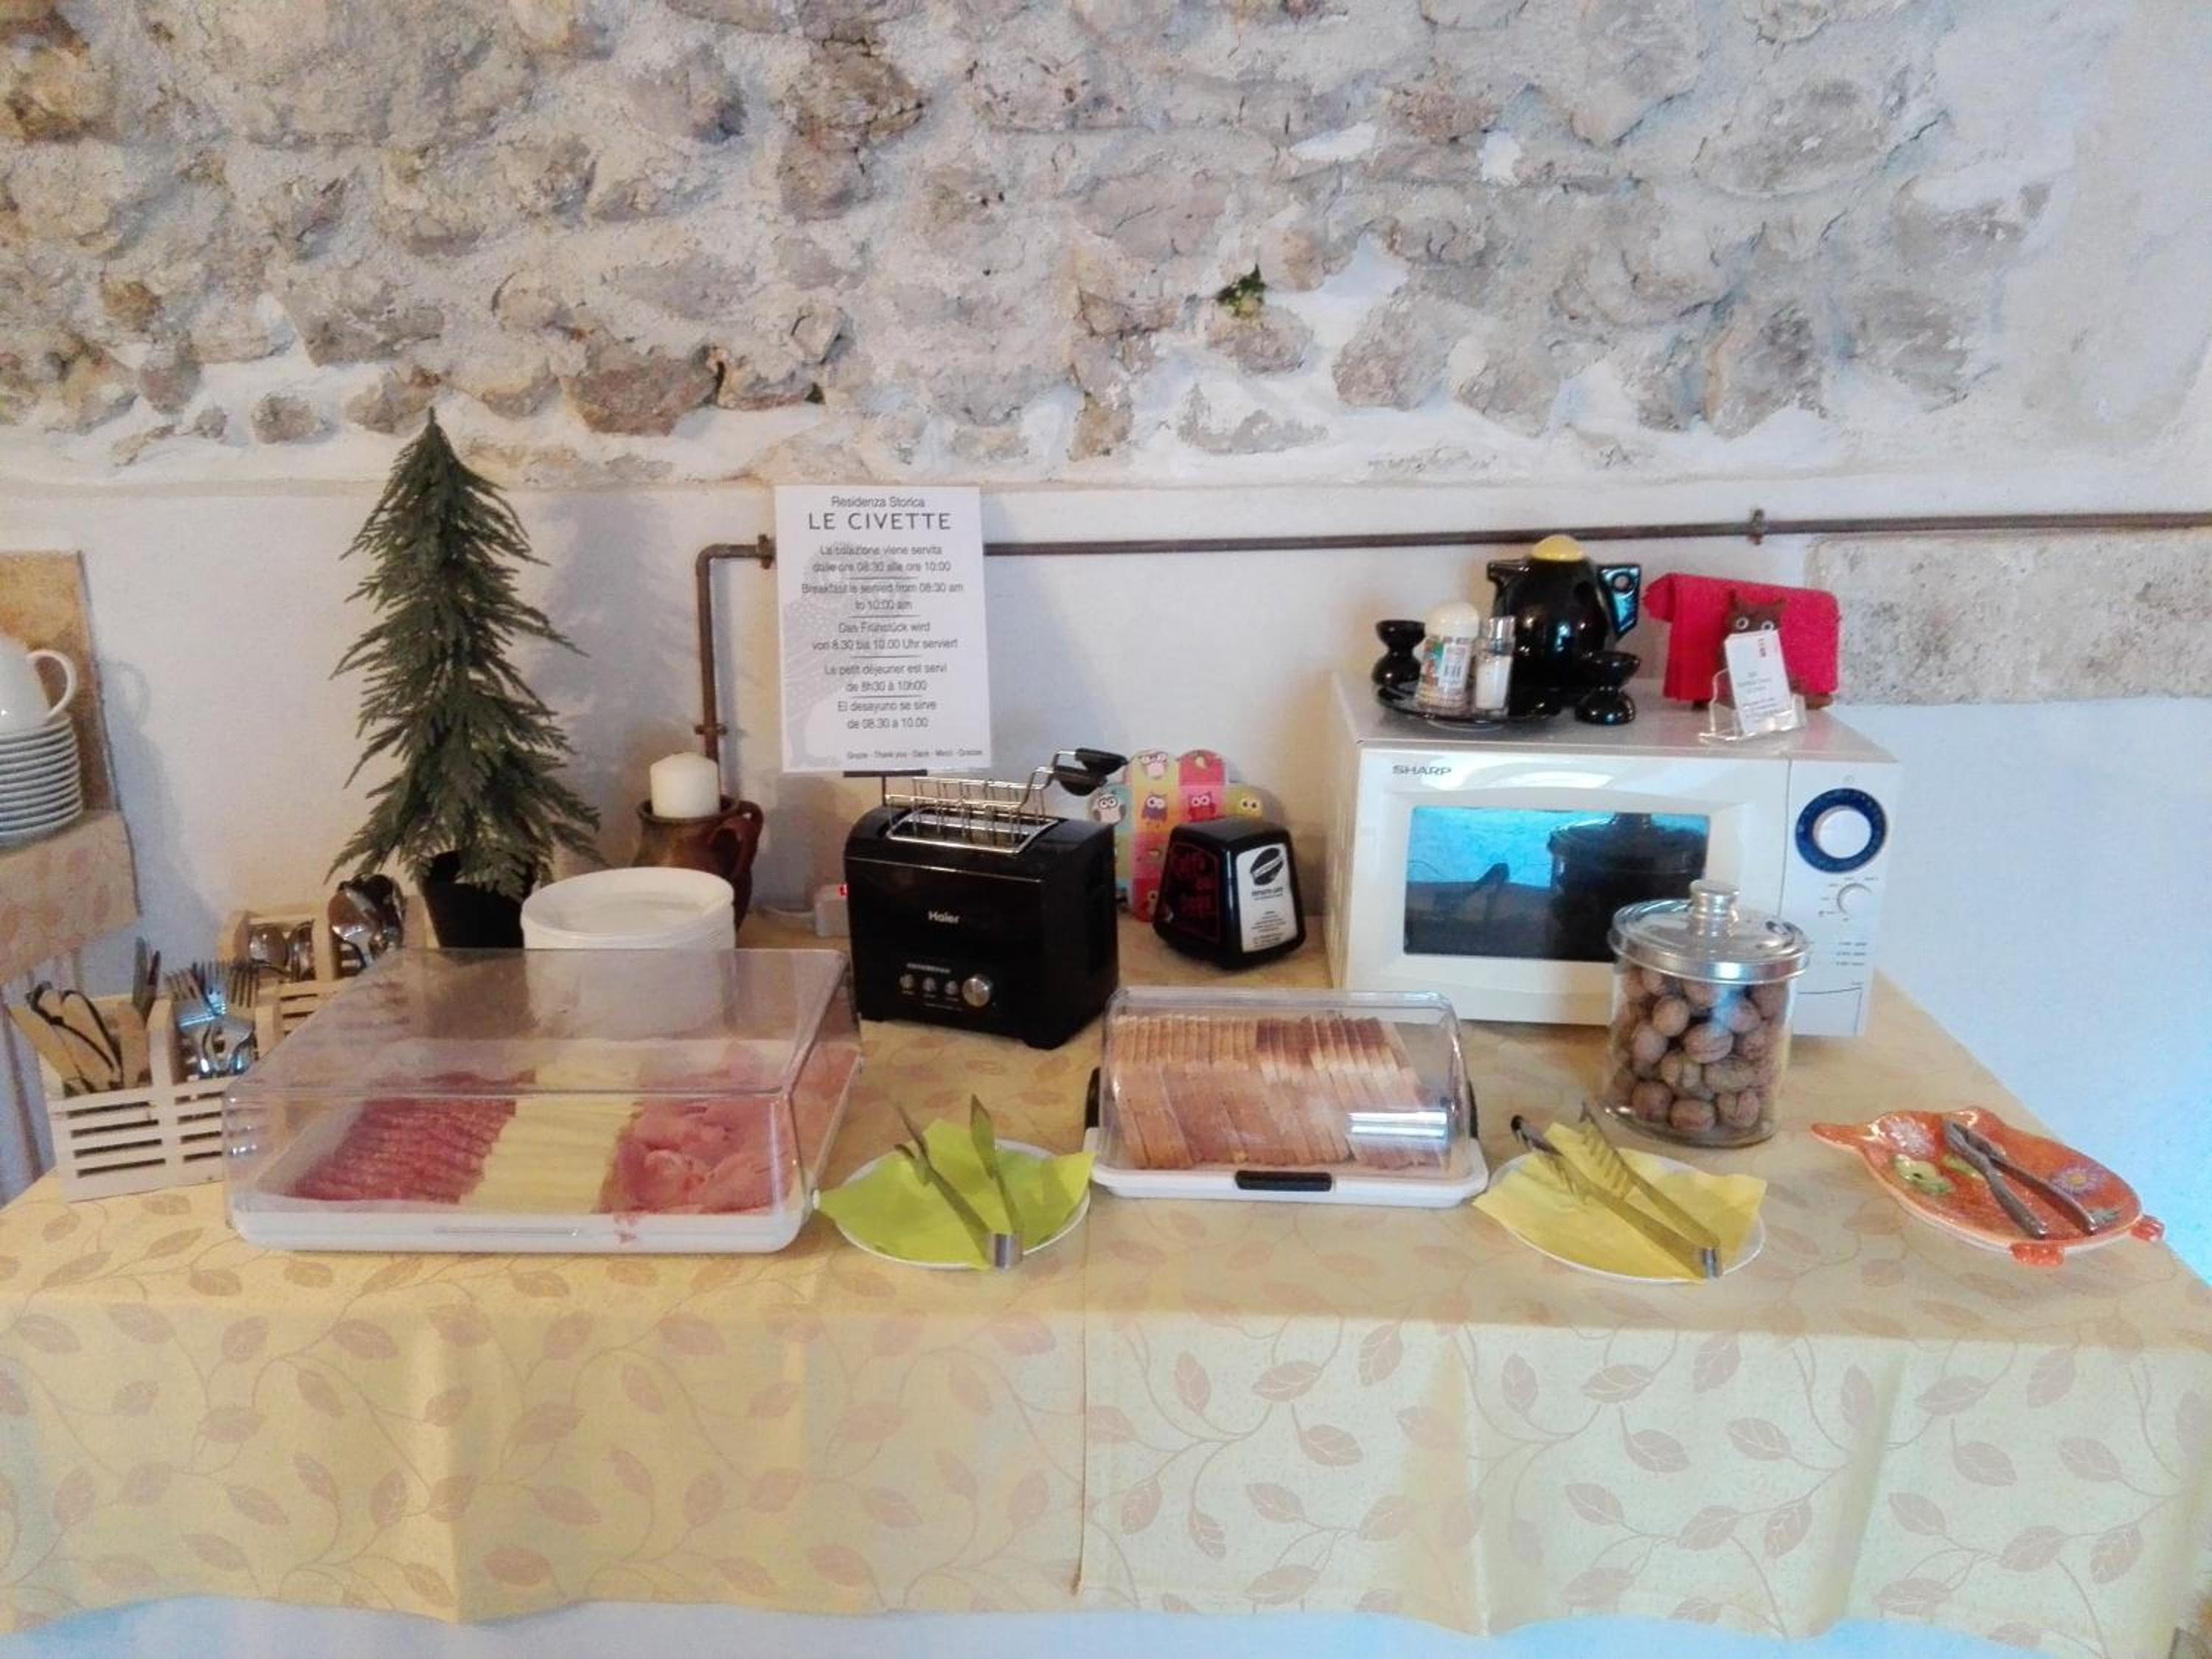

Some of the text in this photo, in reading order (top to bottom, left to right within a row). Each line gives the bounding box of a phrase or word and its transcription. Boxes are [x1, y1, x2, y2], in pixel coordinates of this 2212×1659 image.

[832, 496, 925, 507] Residenza Storica
[809, 512, 950, 529] LE CIVETTE
[885, 544, 908, 554] viene
[912, 544, 942, 554] servita
[911, 621, 930, 631] wird
[902, 638, 919, 649] Uhr
[914, 700, 937, 710] sirve
[1393, 765, 1451, 774] SHARP
[928, 911, 959, 924] Haier
